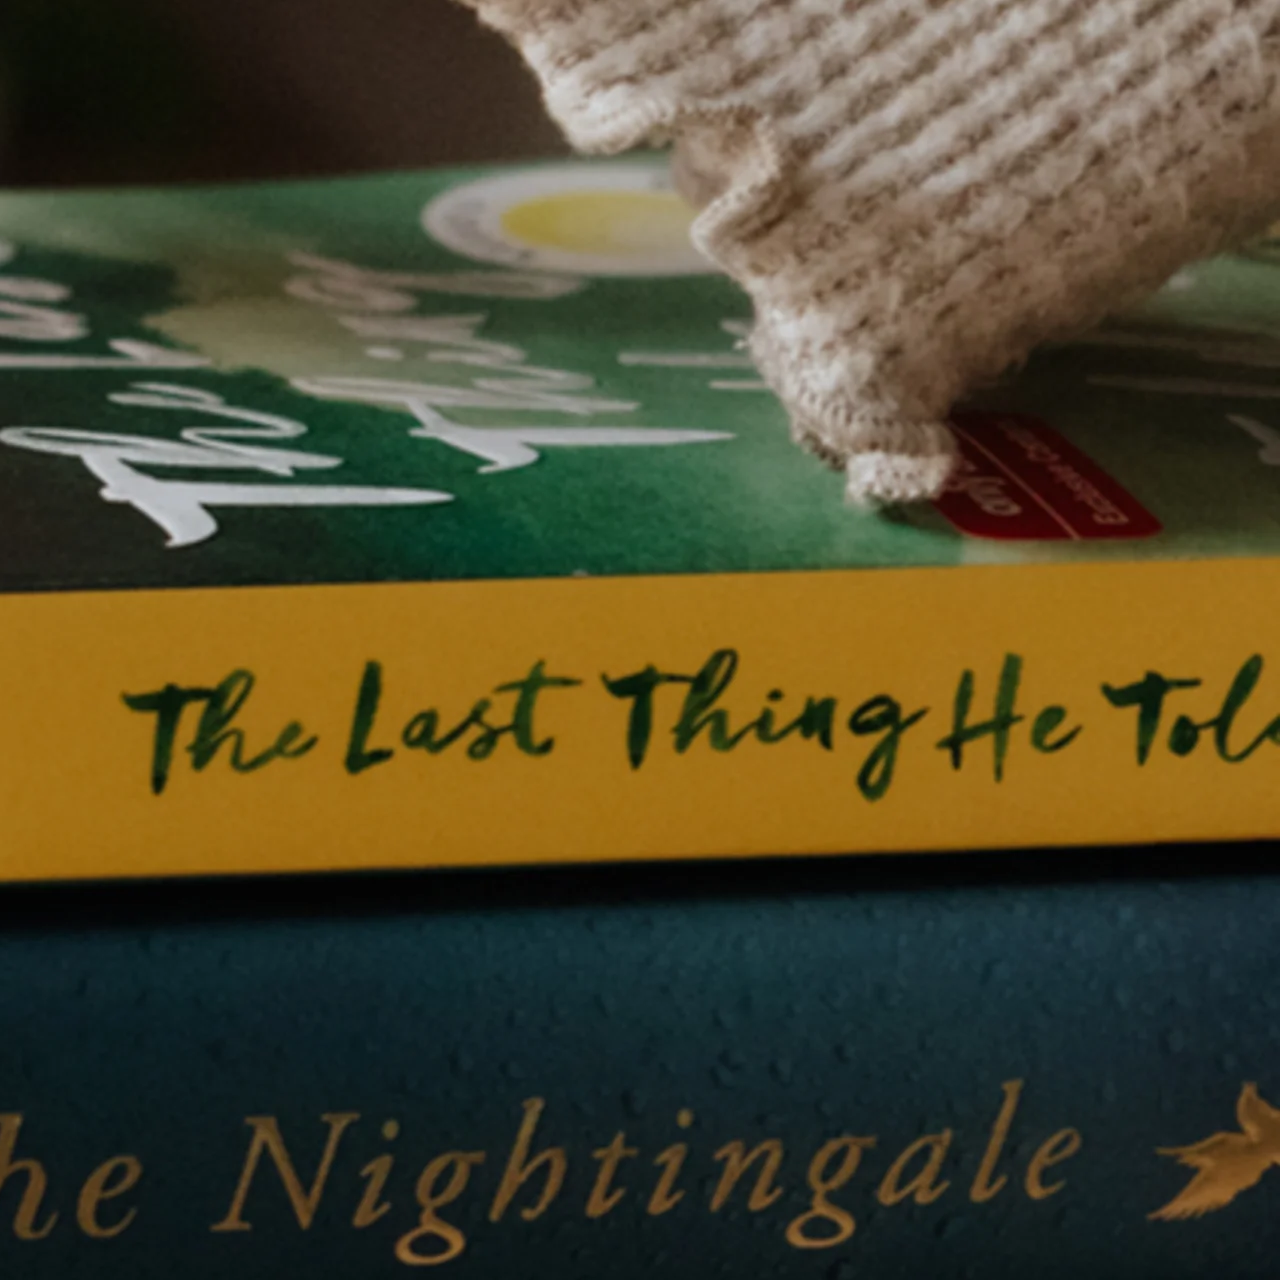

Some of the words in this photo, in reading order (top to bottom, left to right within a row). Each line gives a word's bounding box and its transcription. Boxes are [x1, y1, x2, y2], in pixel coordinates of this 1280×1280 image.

[121, 668, 319, 796] The
[343, 659, 582, 776] Last
[600, 648, 930, 803] Thing
[935, 652, 1083, 783] He
[211, 1080, 1082, 1266] Nightingale
